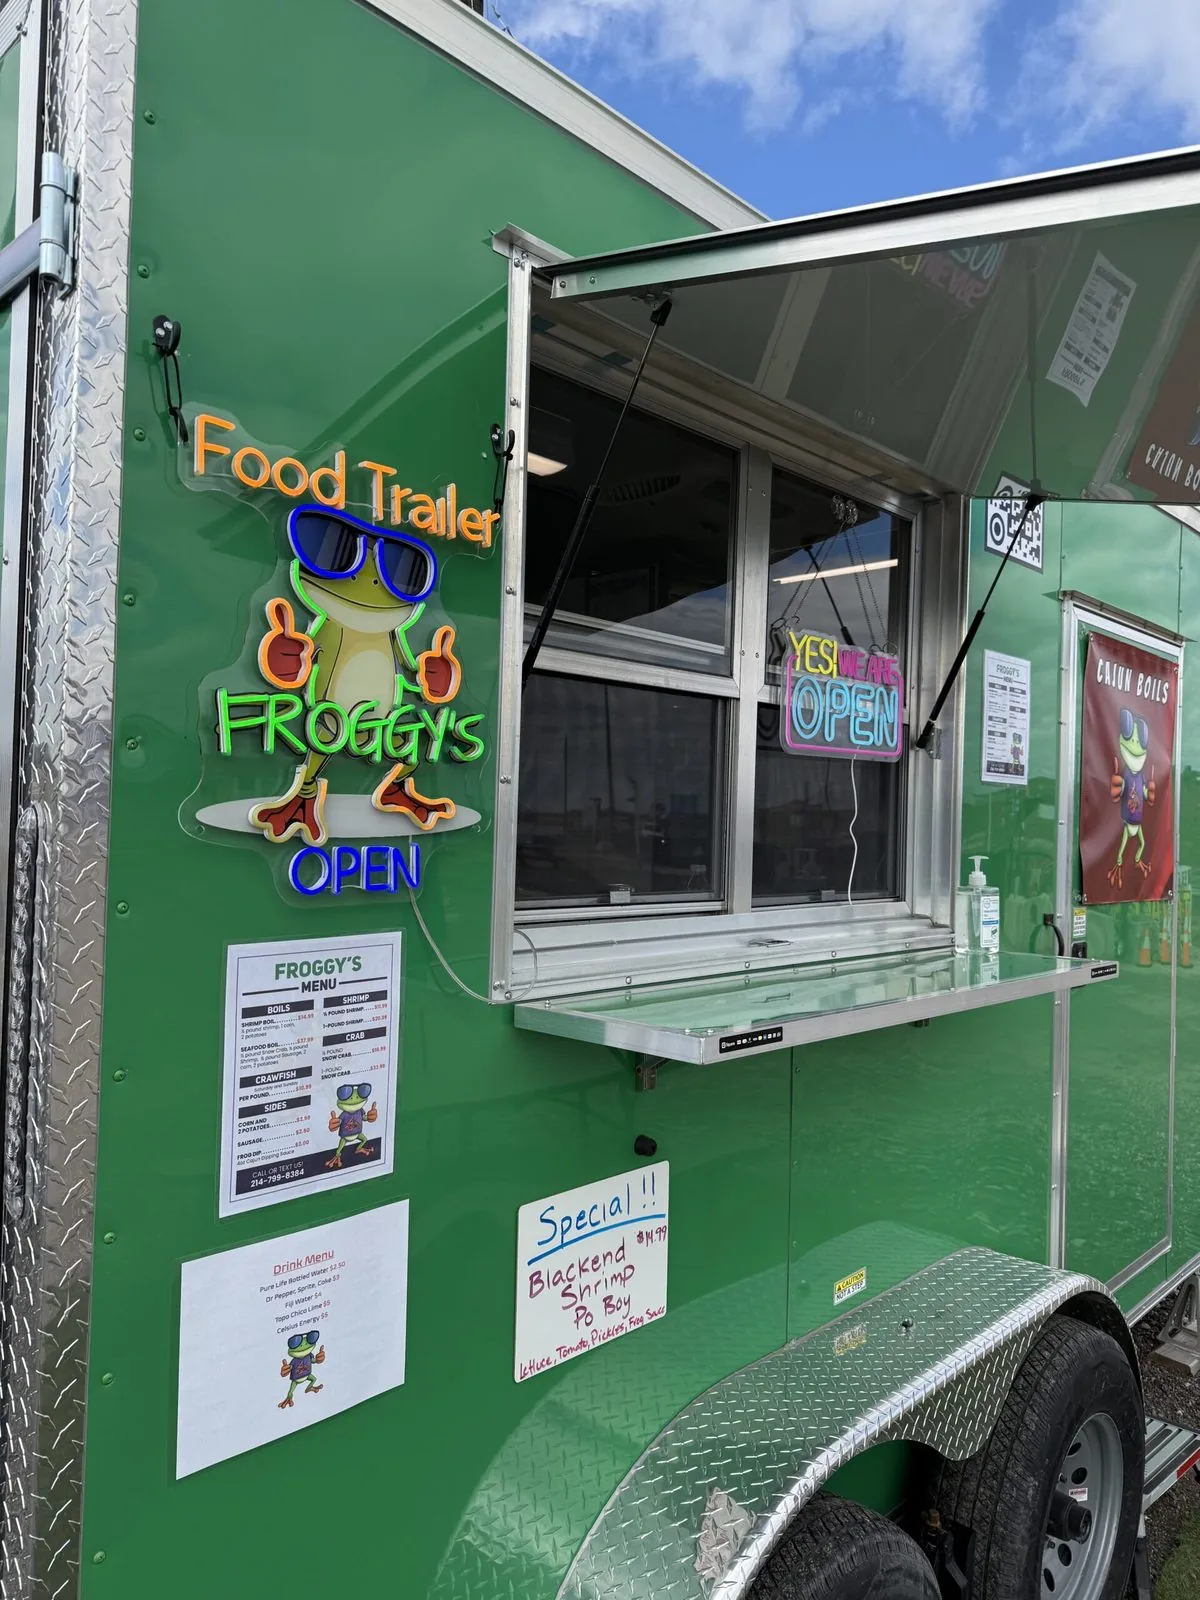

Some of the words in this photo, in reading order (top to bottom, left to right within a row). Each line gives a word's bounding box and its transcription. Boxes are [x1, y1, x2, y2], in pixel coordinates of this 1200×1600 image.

[194, 414, 345, 509] Food
[358, 460, 500, 548] Trailer
[789, 631, 838, 679] YES!
[838, 649, 865, 681] WE
[865, 654, 898, 686] ARE
[1096, 659, 1131, 692] CAJUN
[1137, 672, 1170, 705] BOILS
[792, 675, 898, 748] OPEN
[215, 687, 486, 765] FROGGY'S
[289, 842, 421, 895] OPEN
[275, 955, 362, 980] FROGGY'S
[301, 978, 337, 993] MENU
[342, 994, 370, 1004] SHRIMP
[267, 1004, 291, 1014] BOILS
[346, 1006, 364, 1014] SHRIMP
[241, 1020, 263, 1028] SHRIMP
[345, 1018, 364, 1026] SHRIMP
[345, 1031, 365, 1041] CRAB
[240, 1045, 267, 1053] SEAFOOD
[322, 1054, 338, 1062] SNOW
[255, 1070, 297, 1084] CRAWFISH
[321, 1072, 337, 1080] SNOW
[250, 1092, 270, 1100] POUND
[264, 1101, 287, 1112] SIDES
[238, 1119, 255, 1128] CORN
[255, 1117, 267, 1125] AND
[242, 1124, 270, 1133] POTATOES
[237, 1137, 263, 1147] SAUSAGE
[237, 1152, 253, 1160] FROG
[252, 1170, 268, 1178] CALL
[279, 1163, 293, 1172] TEXT
[250, 1169, 304, 1188] 214-799-8384
[538, 1183, 630, 1249] Special
[636, 1225, 667, 1247] $14.99
[273, 1258, 303, 1275] Drink
[305, 1250, 334, 1265] Menu
[528, 1236, 626, 1298] Blackend
[259, 1284, 275, 1293] Pure
[275, 1280, 288, 1288] Life
[288, 1273, 310, 1285] Bottled
[311, 1267, 329, 1277] Water
[317, 1278, 332, 1287] Coke
[561, 1264, 635, 1311] Shrimp
[841, 1272, 864, 1288] CAUTION
[295, 1295, 314, 1305] Water
[836, 1290, 847, 1301] NOT
[847, 1288, 851, 1296] A
[290, 1308, 307, 1318] Chico
[308, 1303, 322, 1313] Lime
[574, 1305, 594, 1330] Po
[602, 1294, 631, 1319] Boy
[276, 1322, 298, 1334] Celsius
[299, 1316, 320, 1327] Energy
